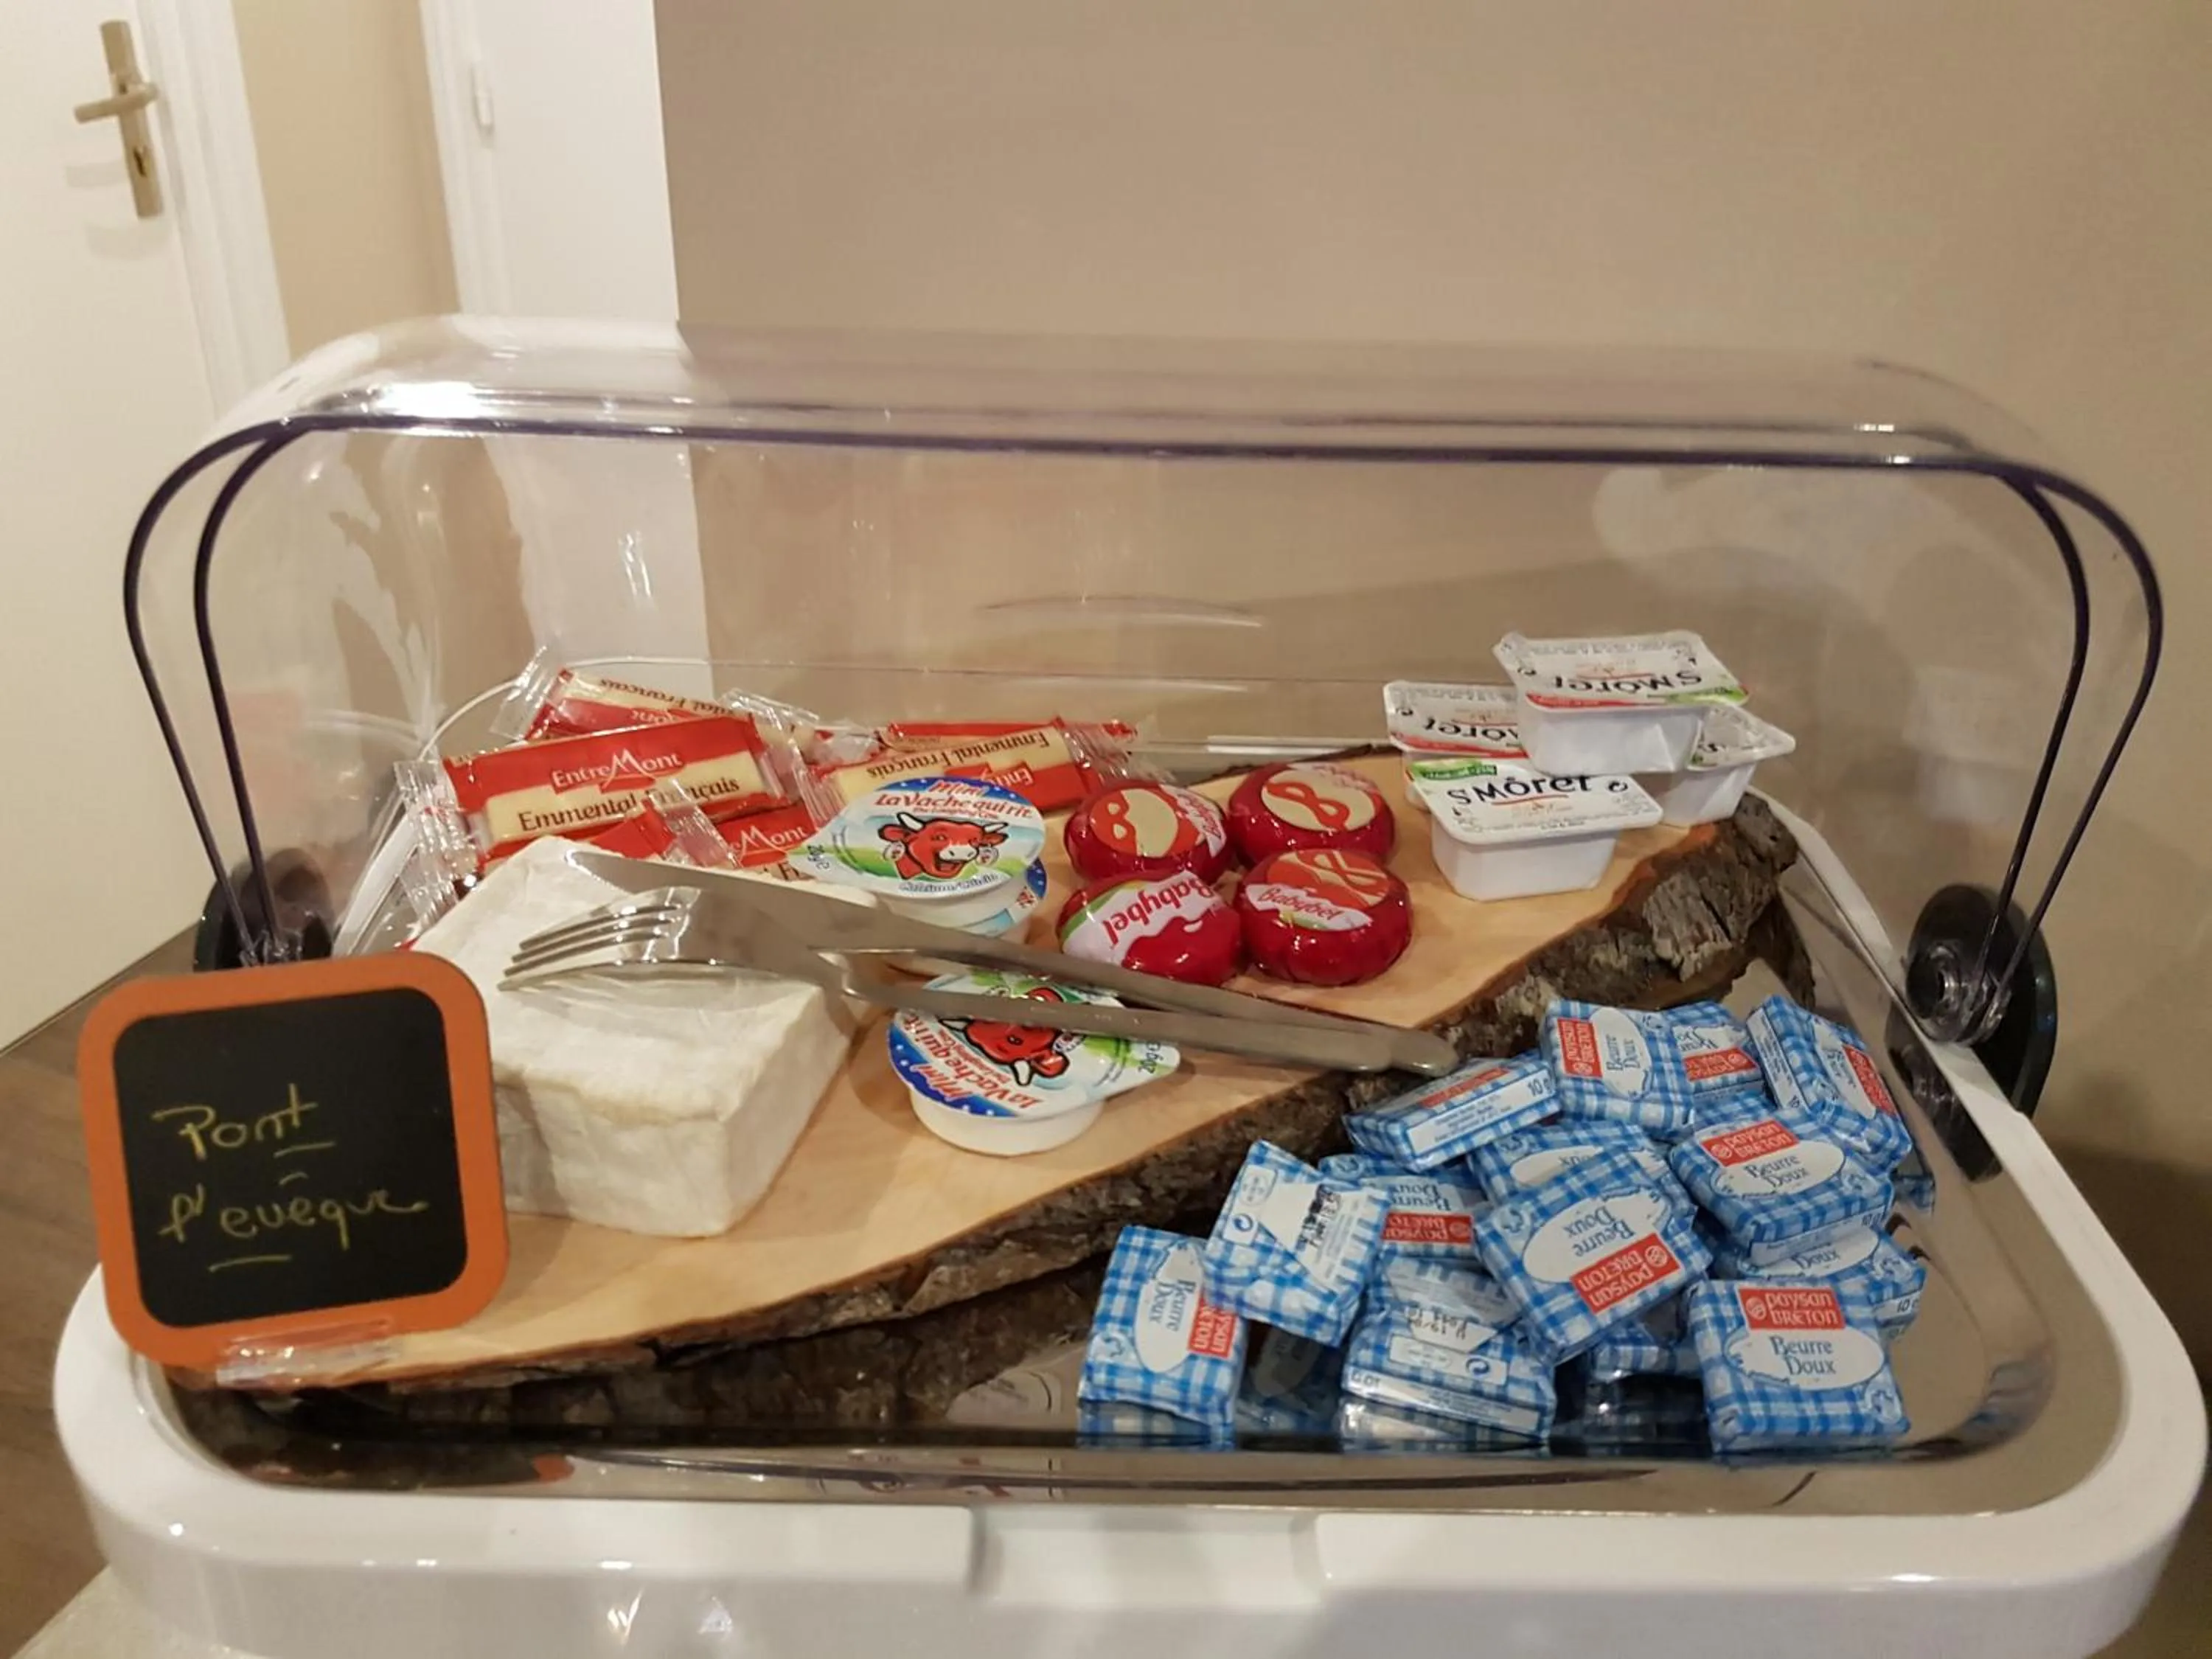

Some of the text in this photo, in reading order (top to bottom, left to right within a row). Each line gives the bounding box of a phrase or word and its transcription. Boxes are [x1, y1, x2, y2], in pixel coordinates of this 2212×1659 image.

[518, 793, 637, 832] Emmental
[1102, 878, 1214, 946] Babybel
[151, 1082, 319, 1161] Pont
[1744, 1155, 1802, 1178] Beurre
[1764, 1166, 1810, 1189] Doux
[1562, 1205, 1615, 1239] Doux
[1571, 1217, 1636, 1257] Beurre
[1150, 1281, 1175, 1324] Doux
[1166, 1279, 1196, 1332] Beurre
[1768, 1335, 1834, 1356] Beurre
[1784, 1354, 1837, 1376] Doux
